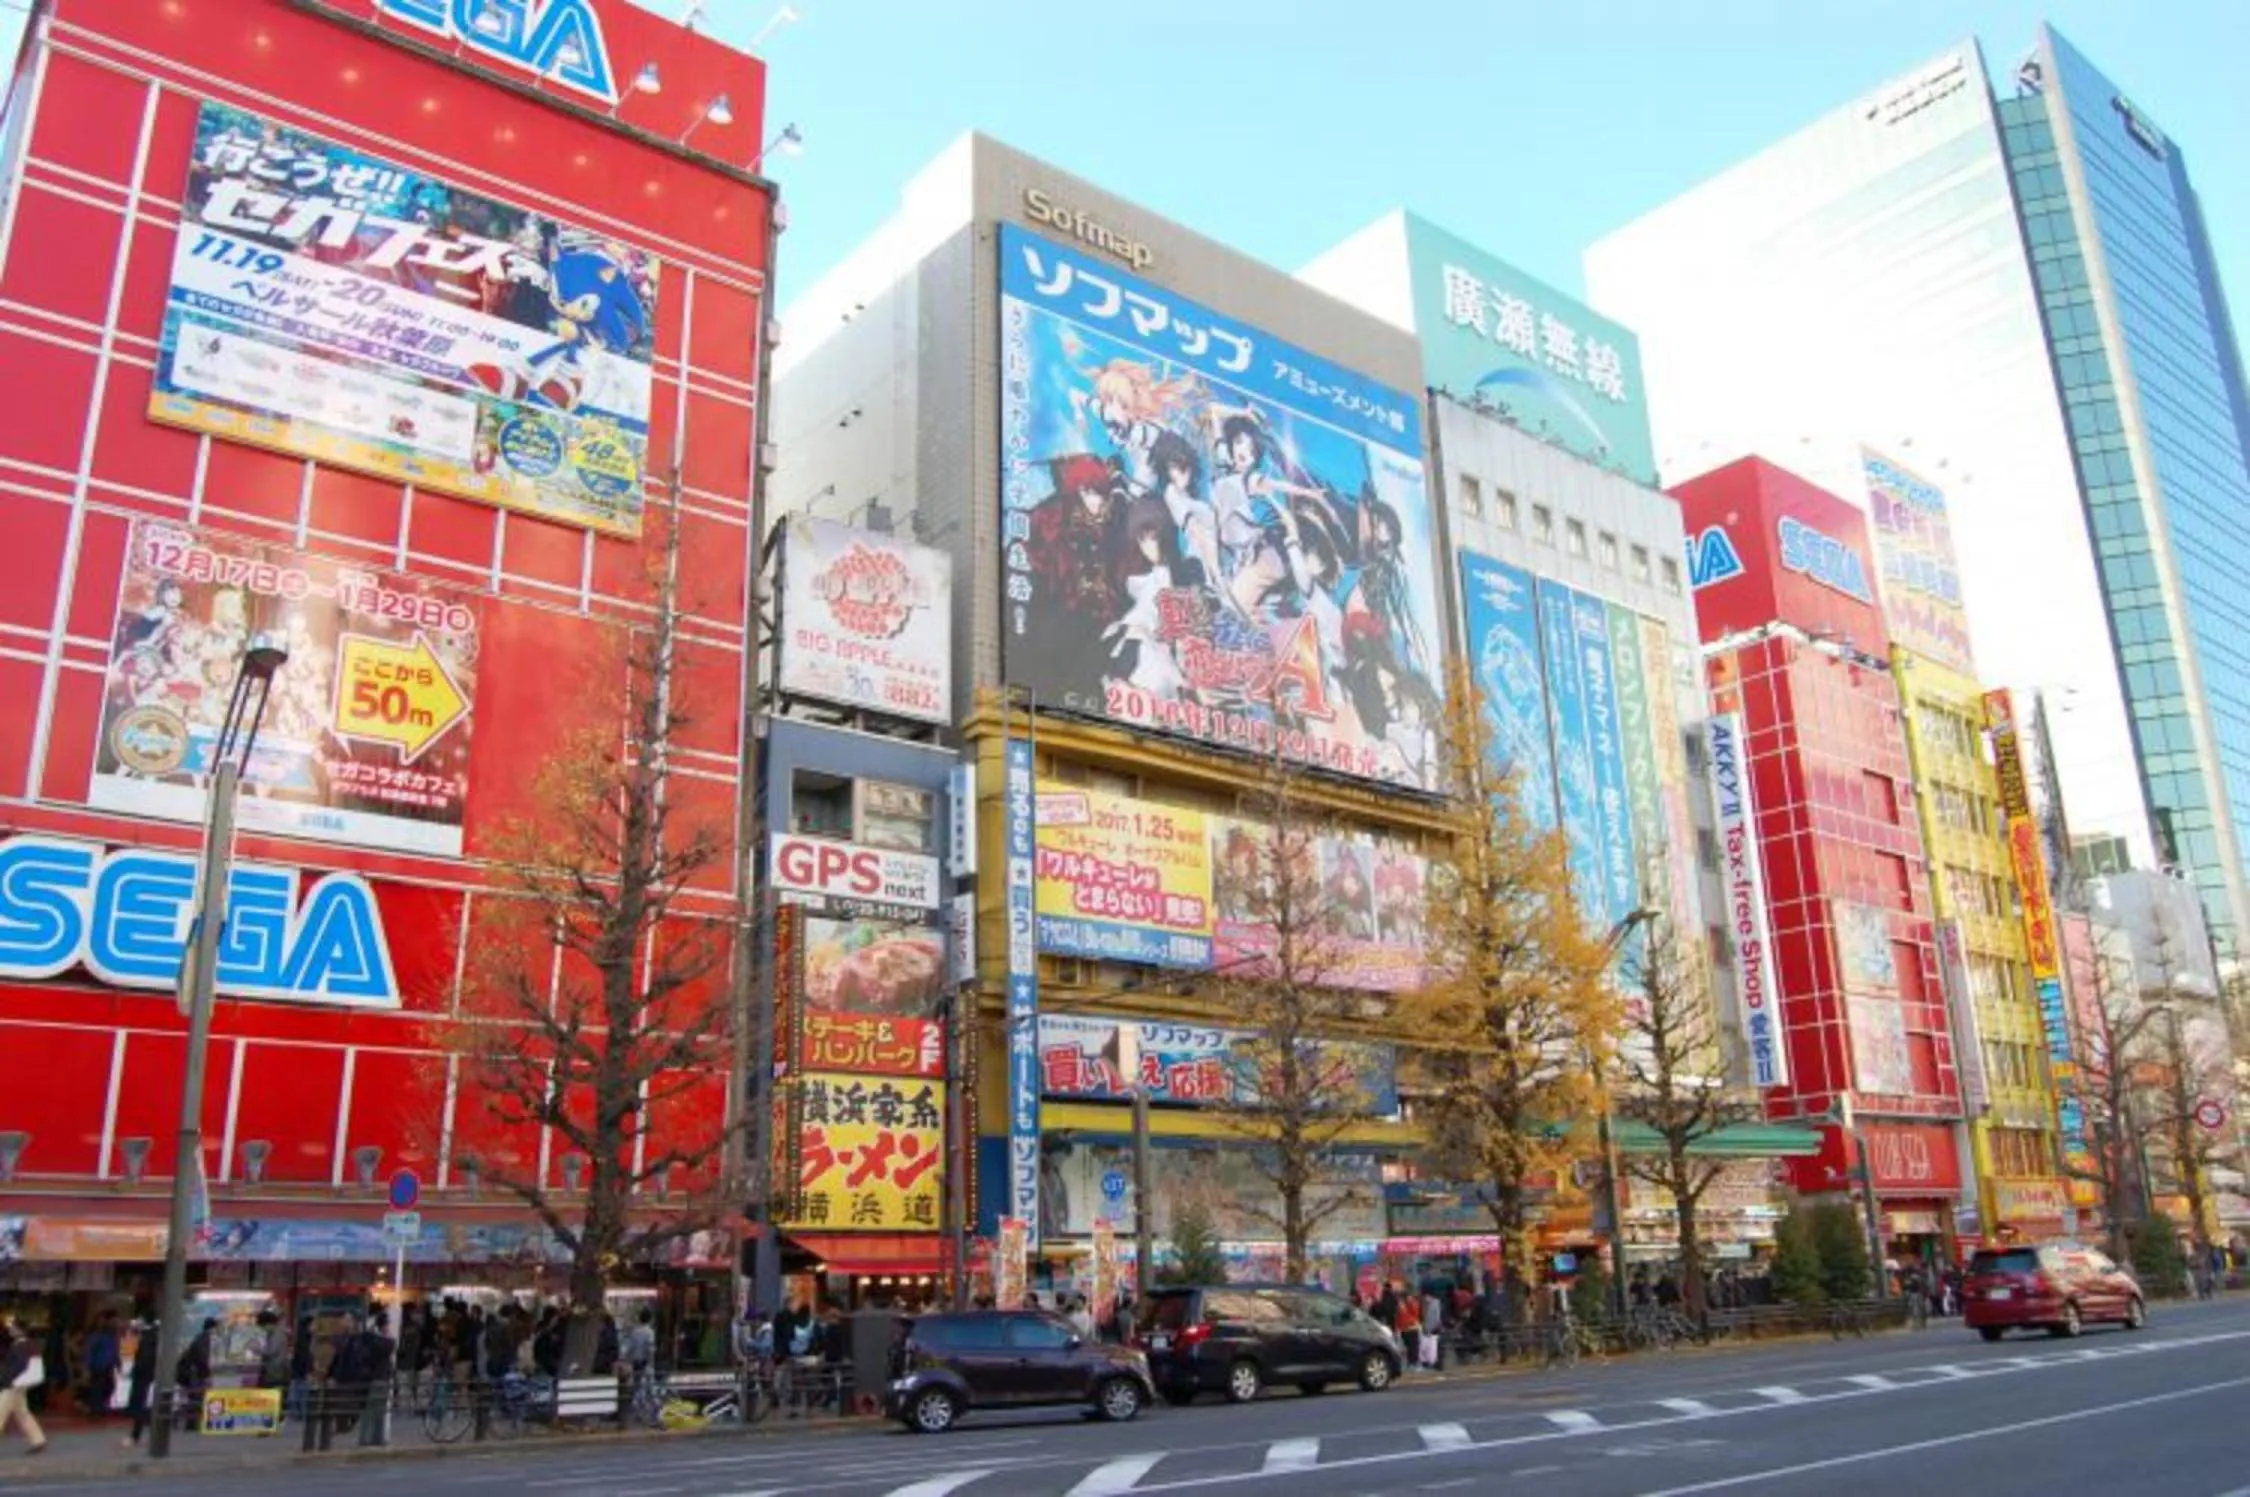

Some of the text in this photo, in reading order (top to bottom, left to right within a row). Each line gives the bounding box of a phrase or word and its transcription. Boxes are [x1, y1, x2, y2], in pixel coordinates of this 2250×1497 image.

[191, 233, 284, 274] 11.19
[200, 178, 512, 284] セガフェス
[1023, 188, 1154, 270] Sofmap
[1022, 244, 1254, 376] ソフマップ
[353, 655, 434, 686] ここから
[349, 678, 433, 727] 50m
[778, 840, 881, 895] GPS
[884, 883, 926, 901] next
[0, 835, 400, 1008] SEGA
[1741, 938, 1764, 1009] Shop
[812, 1041, 918, 1070] ハンバーグ
[920, 1021, 941, 1074] 2F
[1140, 1024, 1223, 1049] ソフマップ
[801, 1079, 940, 1130] 横浜家系
[800, 1126, 941, 1190] ラーメン
[801, 1189, 936, 1226] 横浜道
